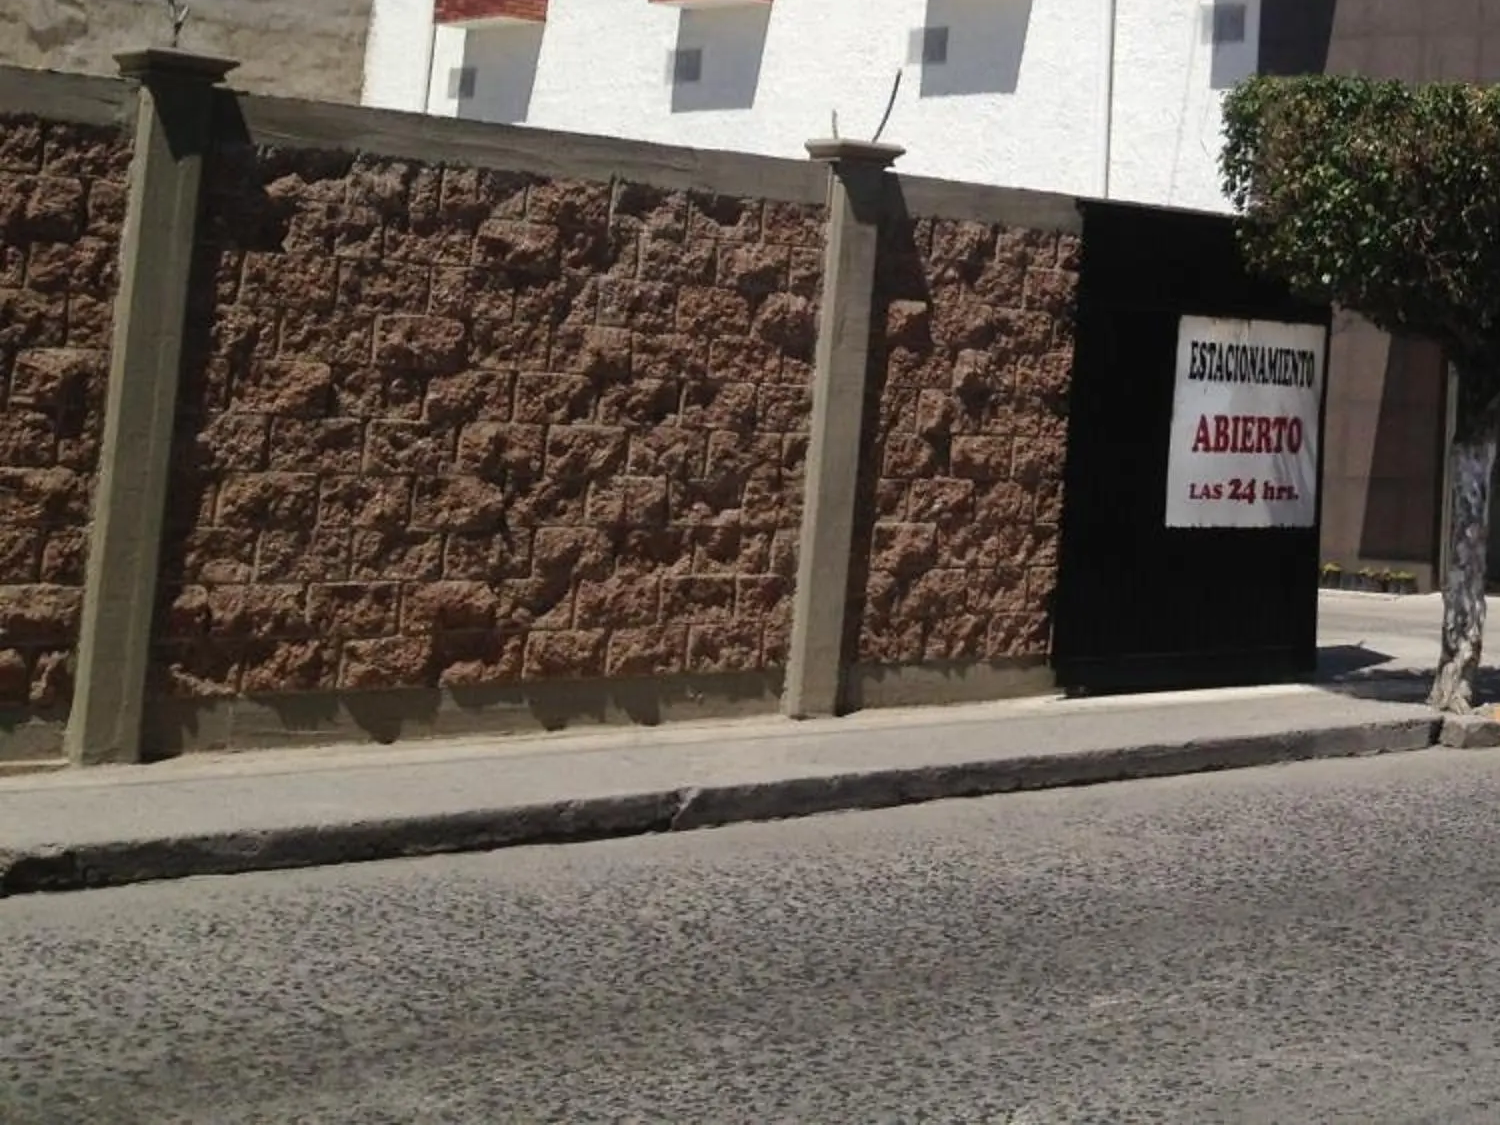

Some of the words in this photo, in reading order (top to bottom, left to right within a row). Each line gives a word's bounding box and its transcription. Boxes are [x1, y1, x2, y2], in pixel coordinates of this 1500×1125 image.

[1188, 340, 1315, 387] ESTACIONAMIENTO
[1191, 414, 1302, 454] ABIERTO
[1189, 483, 1222, 500] LAS
[1228, 478, 1256, 504] 24
[1262, 480, 1299, 500] hrs.
